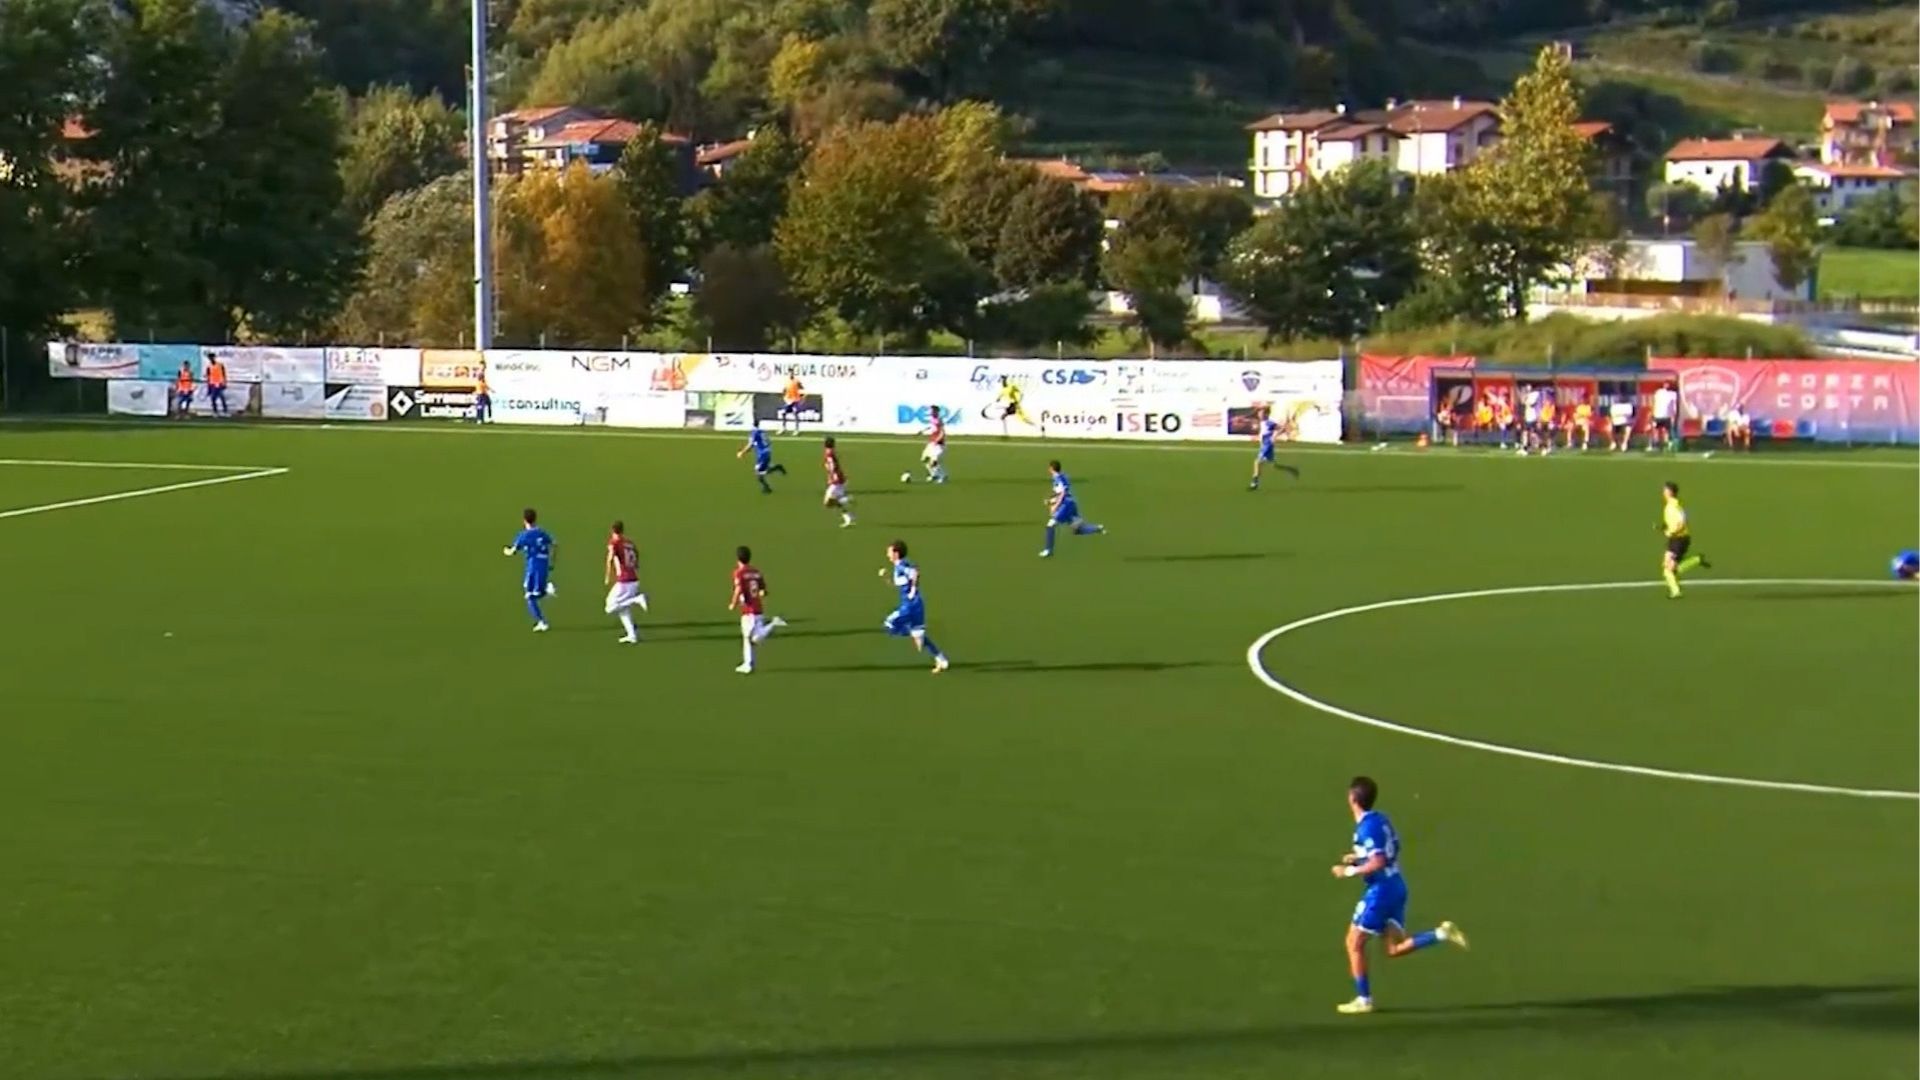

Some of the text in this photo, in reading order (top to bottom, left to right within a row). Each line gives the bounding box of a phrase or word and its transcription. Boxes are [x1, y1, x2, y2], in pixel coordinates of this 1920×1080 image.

[572, 355, 630, 372] NGM
[1041, 411, 1108, 425] Passion
[1117, 413, 1182, 433] ISEO
